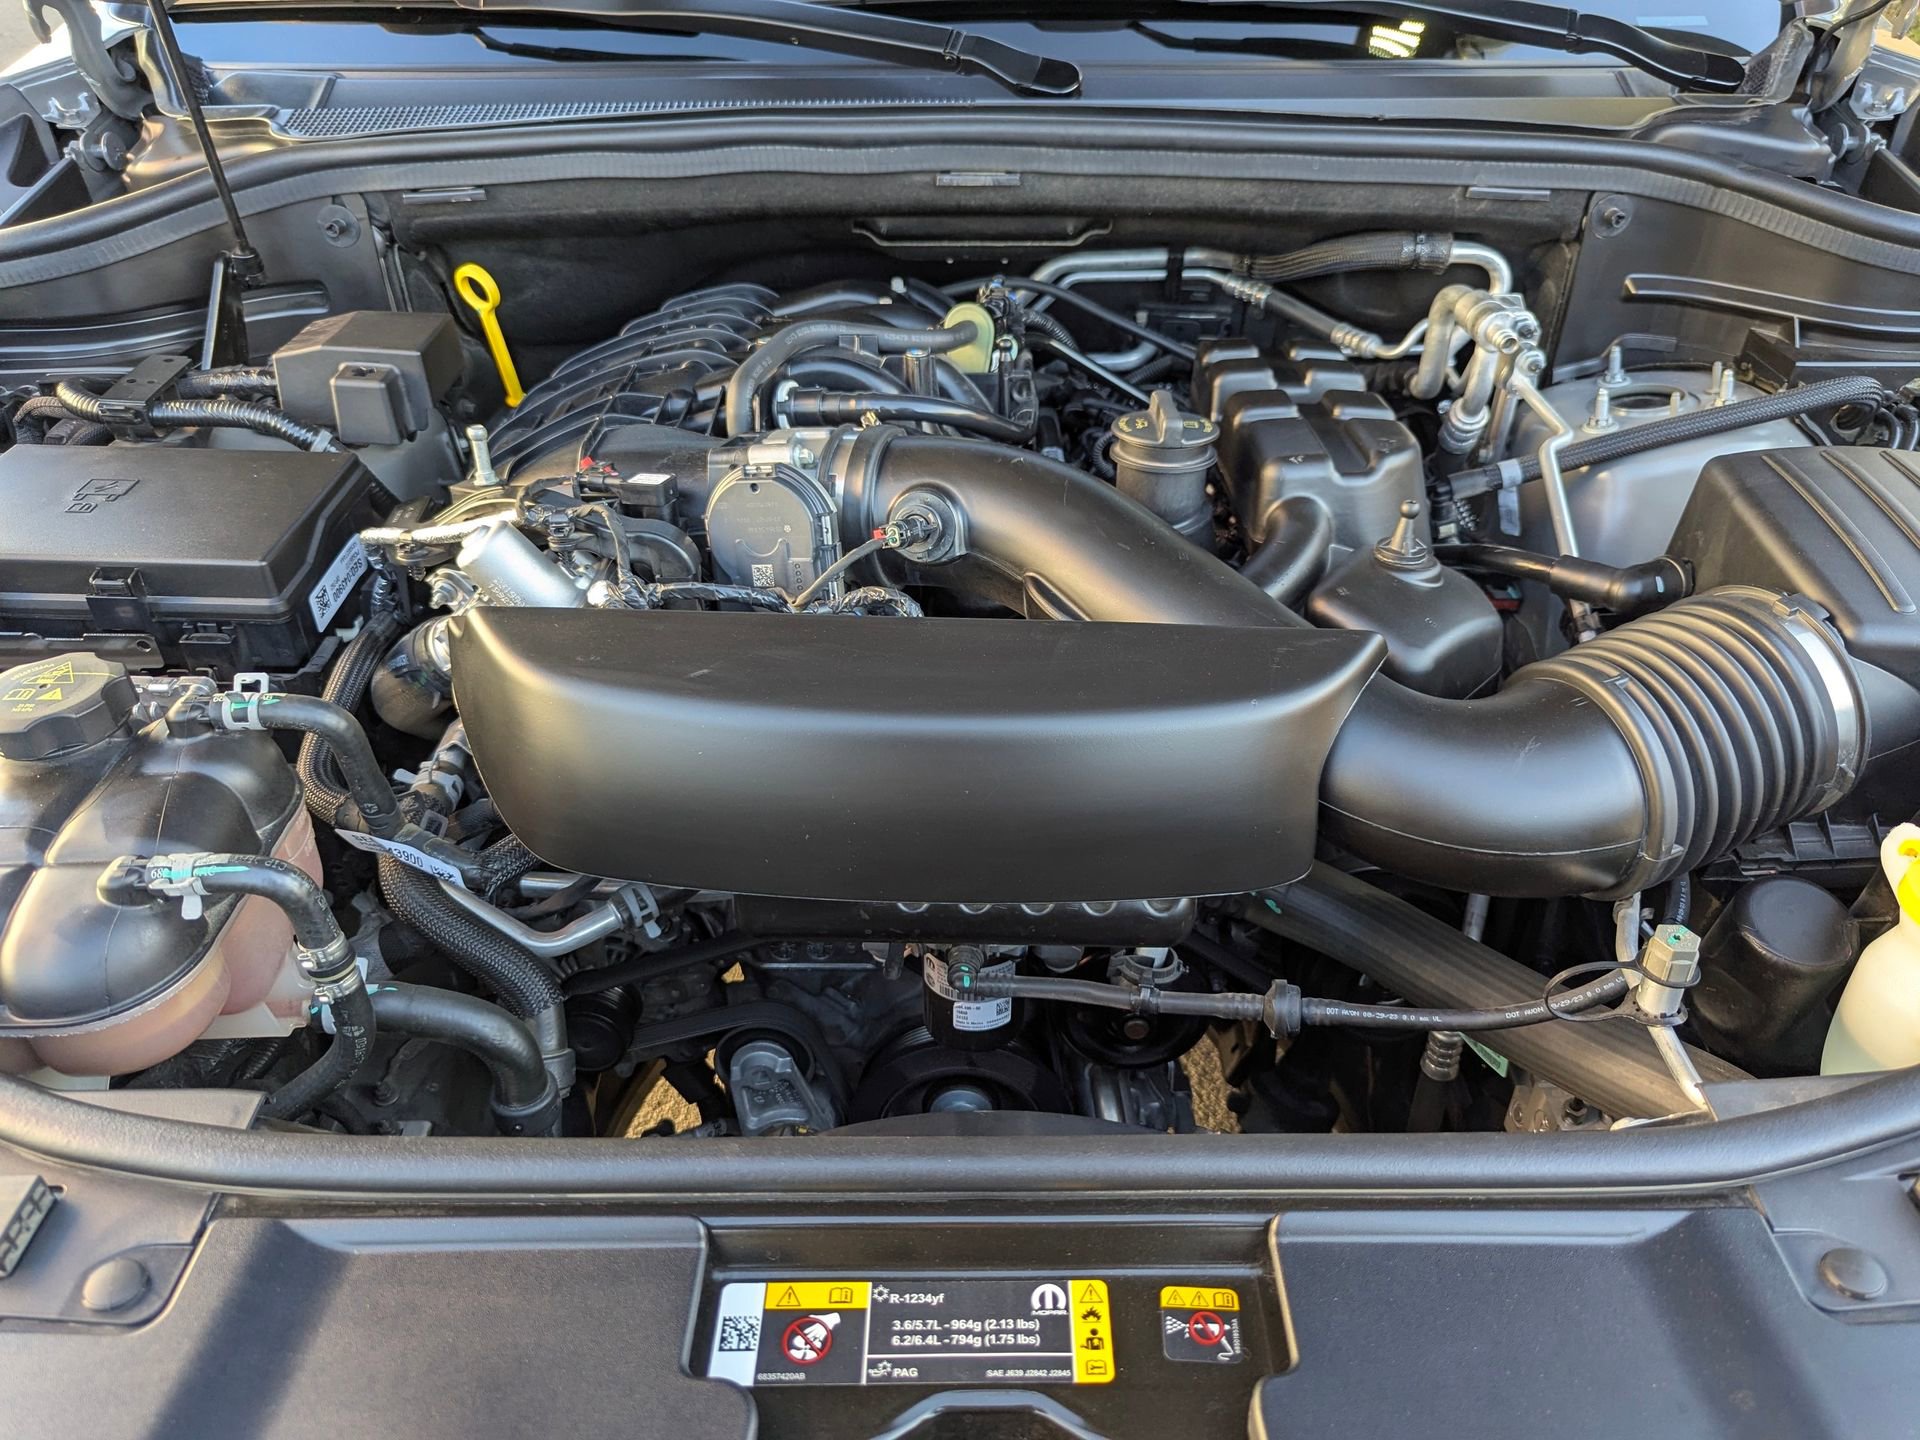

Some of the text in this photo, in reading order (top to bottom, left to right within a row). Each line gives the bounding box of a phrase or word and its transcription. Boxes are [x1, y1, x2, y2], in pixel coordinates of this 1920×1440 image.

[1326, 1008, 1339, 1016] DOT
[1505, 1011, 1520, 1020] DOT
[889, 1293, 944, 1306] R-1234yf
[892, 1319, 942, 1331] 3.6/5.7L
[951, 1319, 982, 1332] 964g
[984, 1318, 1014, 1331] (2.13
[1016, 1318, 1040, 1331] lbs)
[891, 1335, 942, 1346] 6.2/6.4L
[951, 1334, 982, 1347] 794g
[984, 1333, 1015, 1346] (1.75
[1016, 1334, 1041, 1346] lbs)
[892, 1367, 919, 1377] PAG
[986, 1369, 1004, 1377] SAE
[1005, 1369, 1024, 1377] J639
